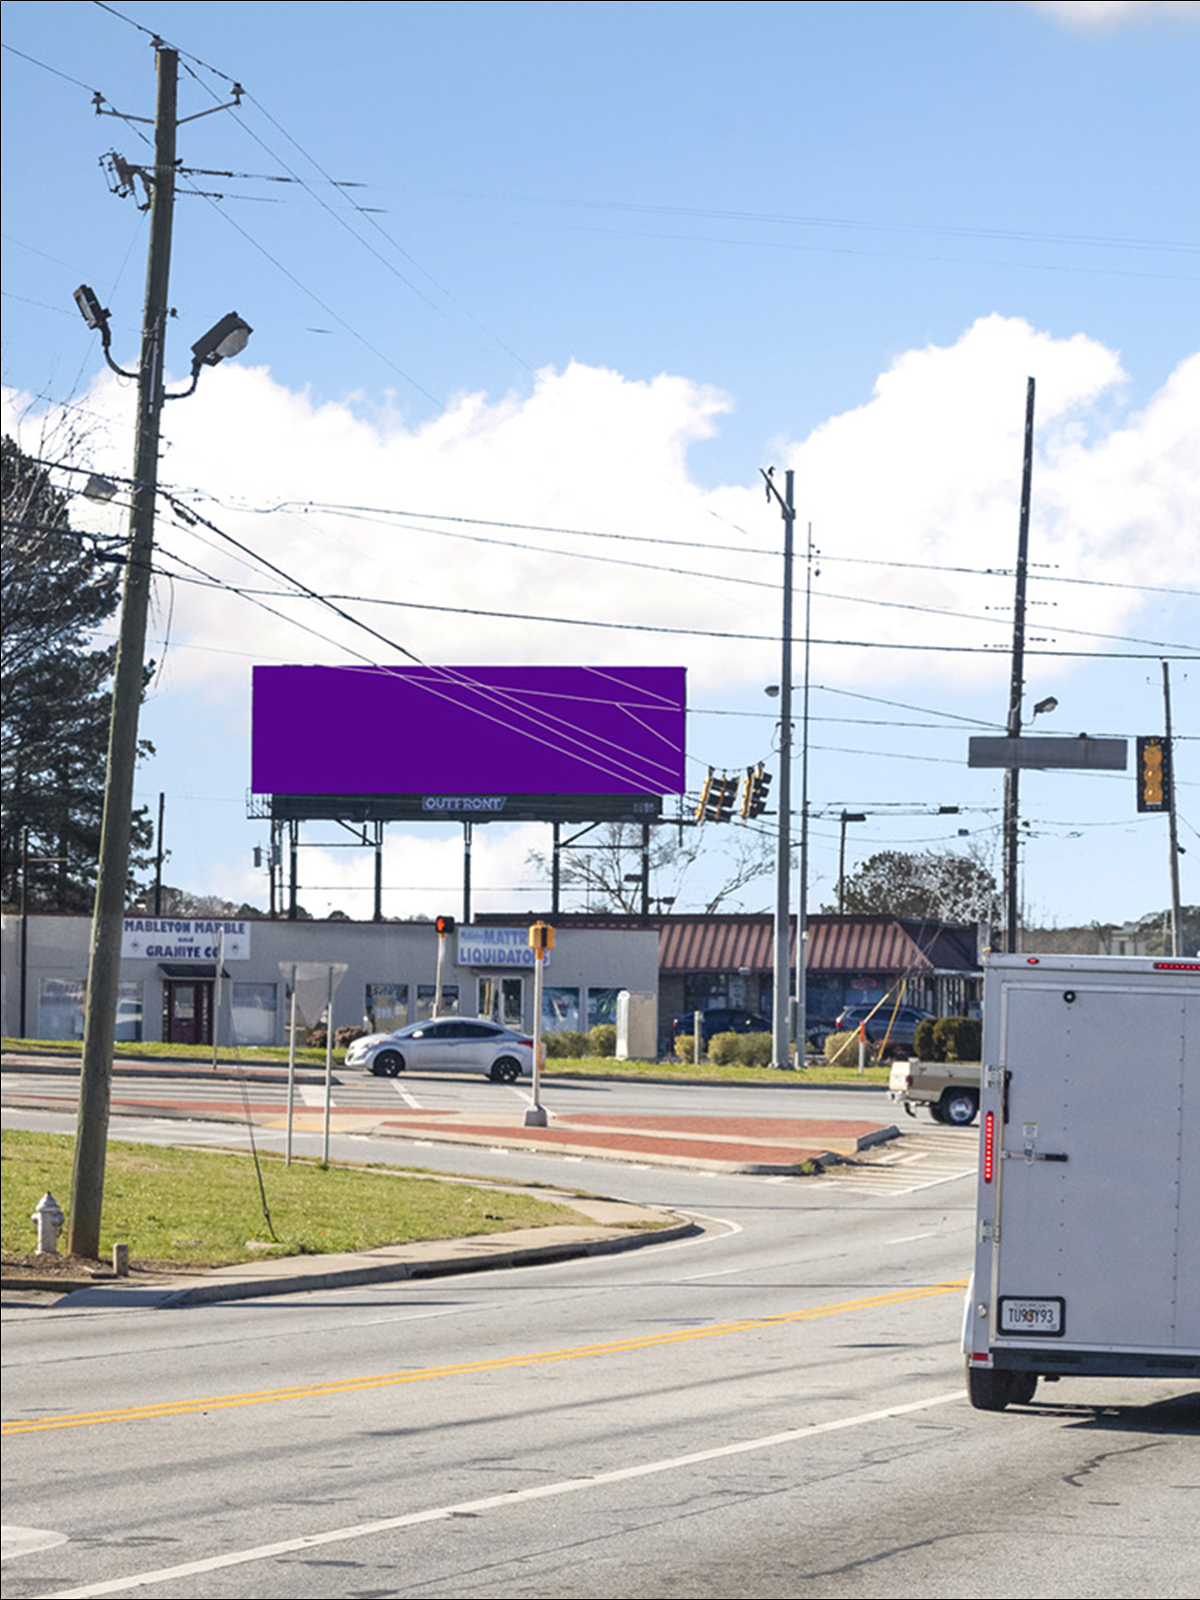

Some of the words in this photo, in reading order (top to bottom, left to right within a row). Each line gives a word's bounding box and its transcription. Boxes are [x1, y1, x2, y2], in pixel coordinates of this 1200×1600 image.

[425, 797, 501, 809] OUTFRONT
[124, 920, 191, 933] MABLETON
[483, 930, 529, 945] MATTR
[146, 945, 201, 958] GRANITE
